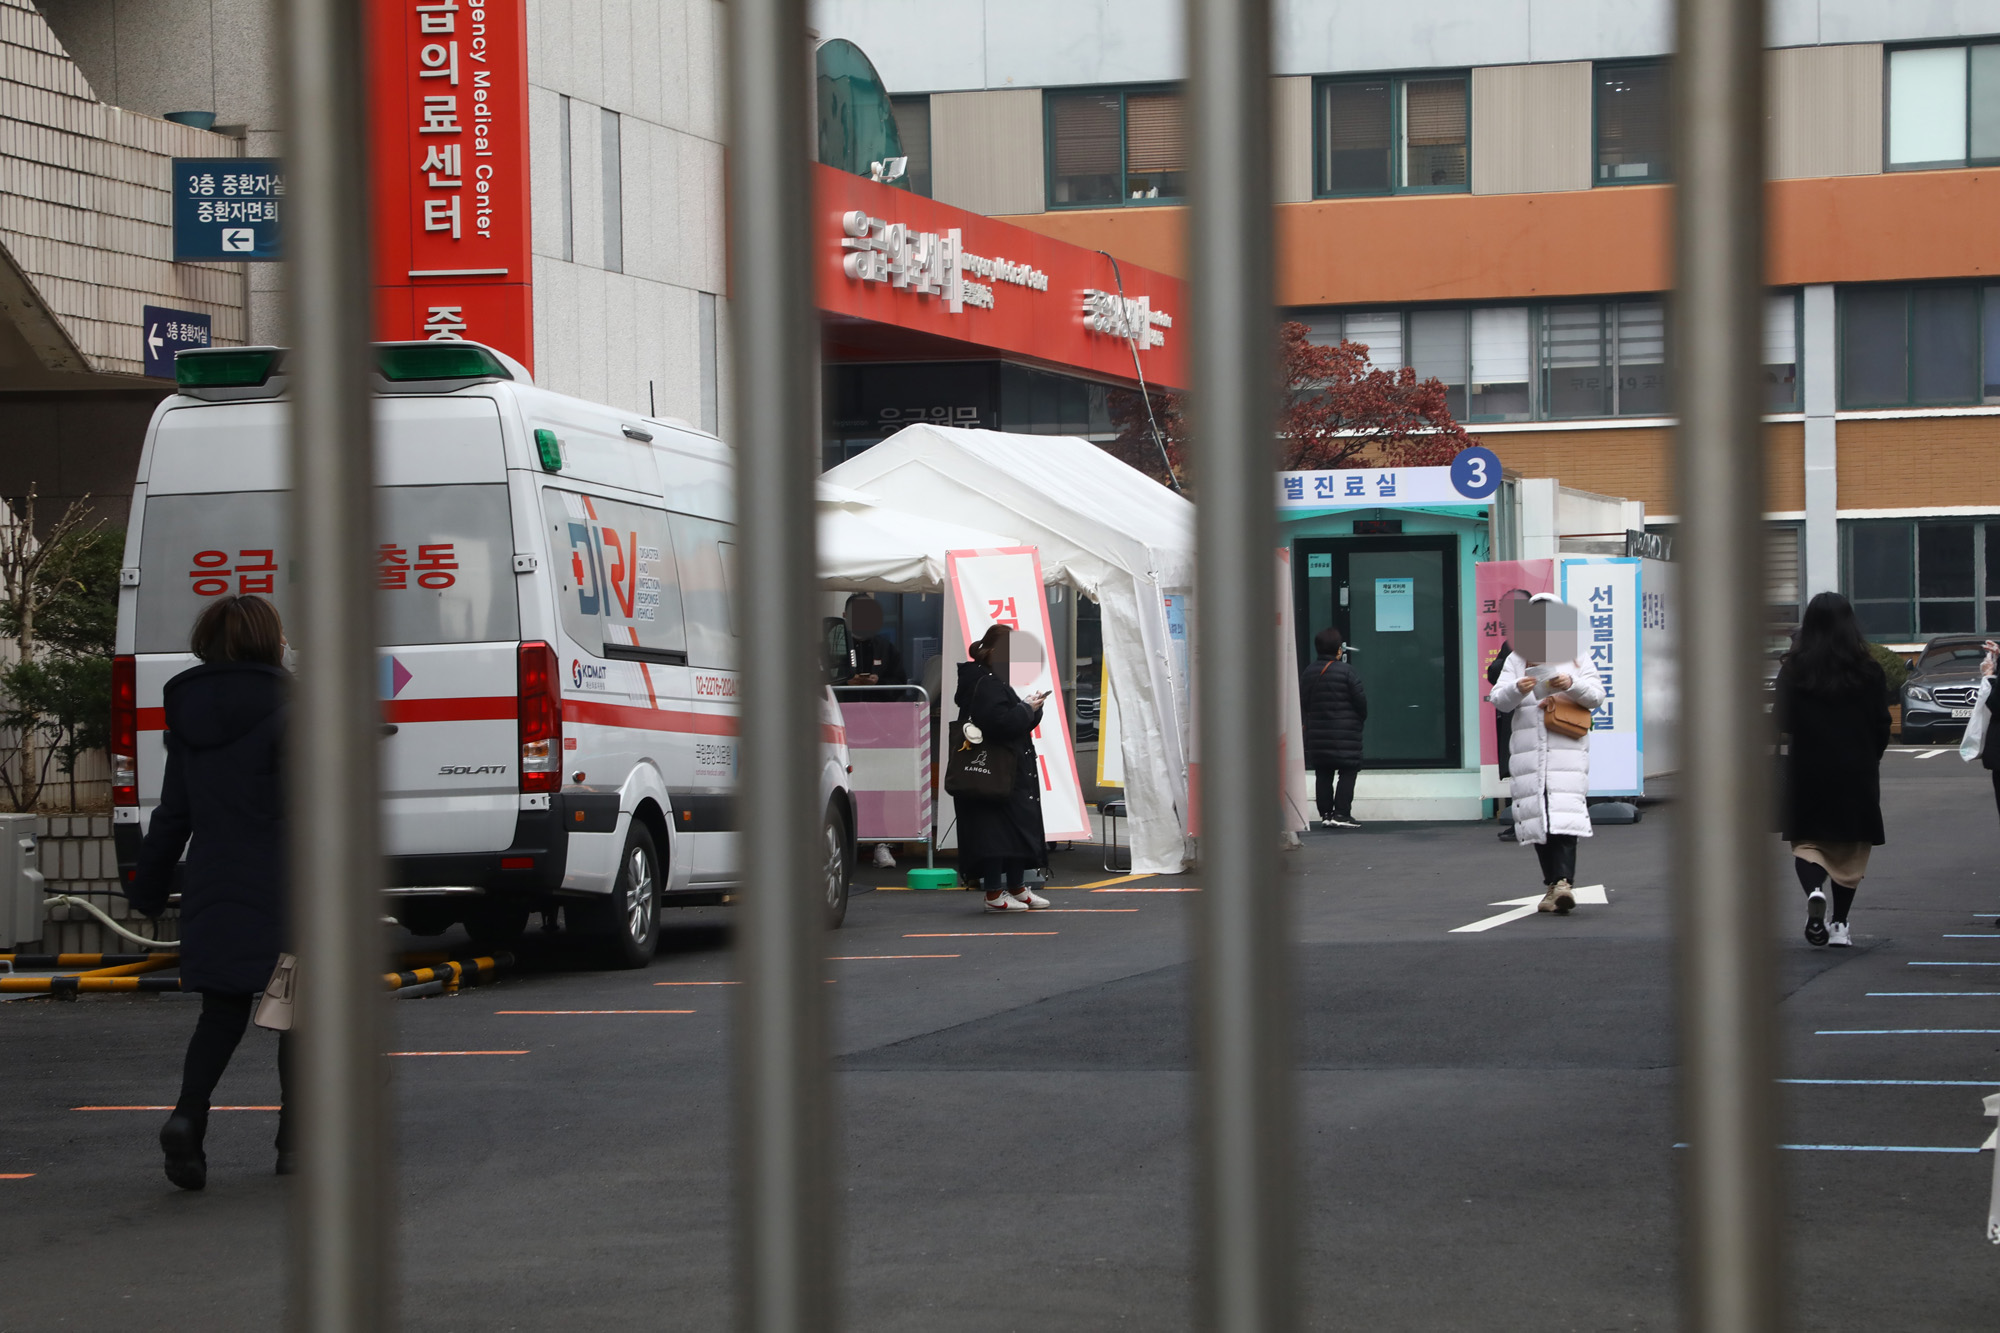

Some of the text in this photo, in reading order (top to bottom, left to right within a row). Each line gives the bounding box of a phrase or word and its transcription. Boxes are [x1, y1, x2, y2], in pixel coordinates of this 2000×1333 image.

[474, 71, 492, 156] Medical
[189, 174, 216, 196] 3층
[476, 165, 493, 239] Center
[841, 210, 963, 313] 응급의료센터
[180, 324, 208, 344] 중환자실
[1466, 457, 1488, 488] 3
[1284, 474, 1397, 500] 별진료실
[189, 543, 459, 596] 응급 출동
[438, 765, 506, 775] SOLATI
[964, 765, 991, 775] KANGOL
